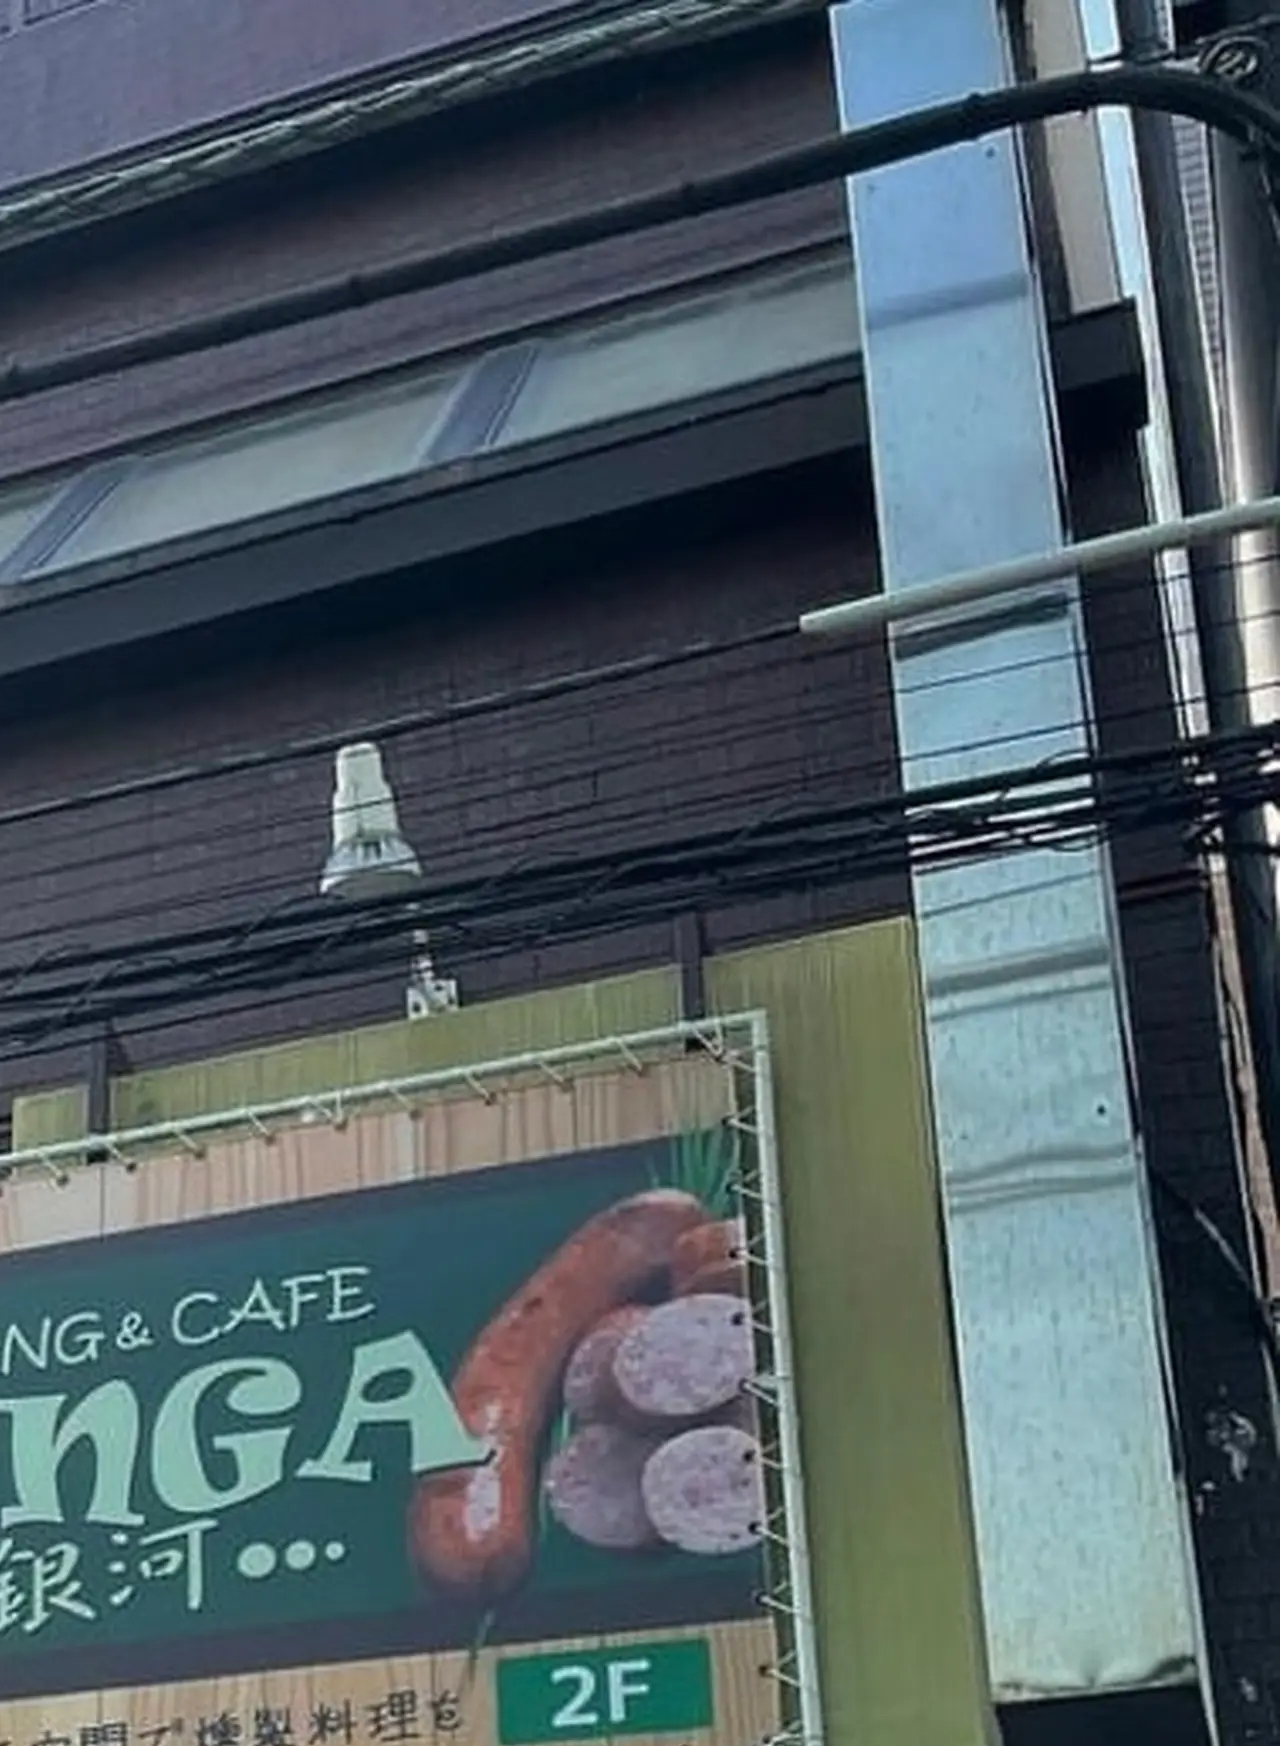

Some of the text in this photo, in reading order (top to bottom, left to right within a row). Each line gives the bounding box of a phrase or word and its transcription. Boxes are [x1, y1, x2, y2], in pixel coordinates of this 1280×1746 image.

[116, 1315, 153, 1350] &
[171, 1266, 376, 1346] CAFE
[550, 1659, 651, 1727] 2F
